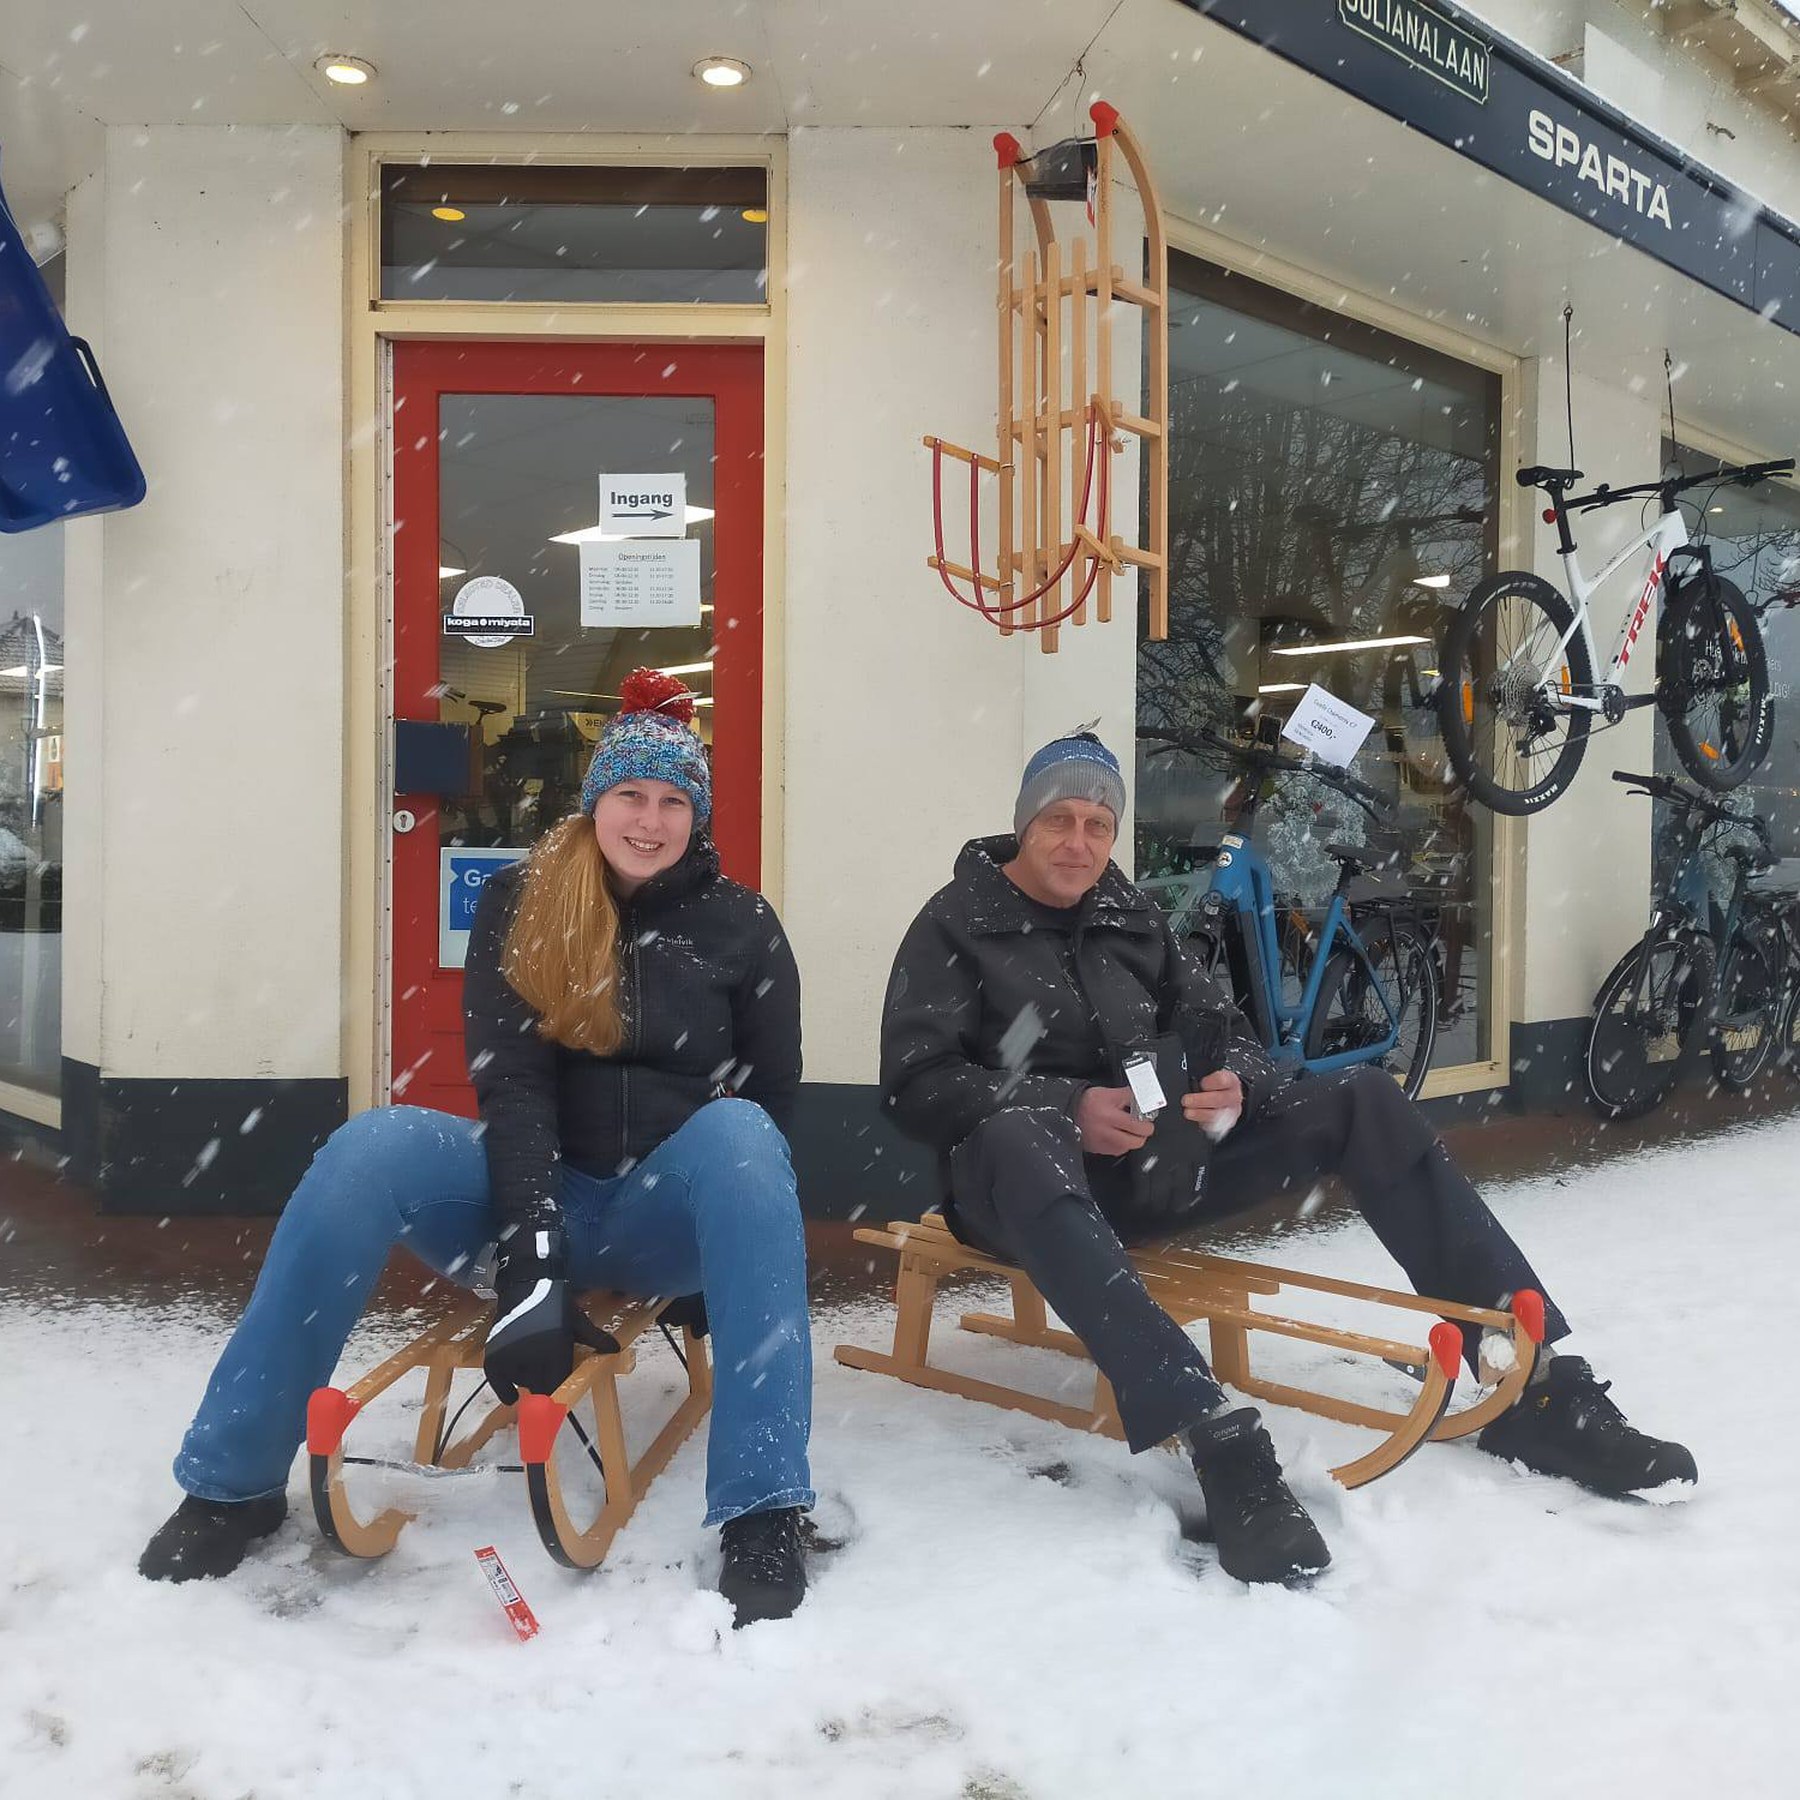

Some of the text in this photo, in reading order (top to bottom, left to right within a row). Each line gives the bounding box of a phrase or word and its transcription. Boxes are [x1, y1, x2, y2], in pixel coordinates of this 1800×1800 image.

[1528, 110, 1672, 230] SPARTA
[610, 491, 673, 508] Ingang
[447, 617, 530, 627] koga miyata
[1616, 549, 1666, 670] TREK
